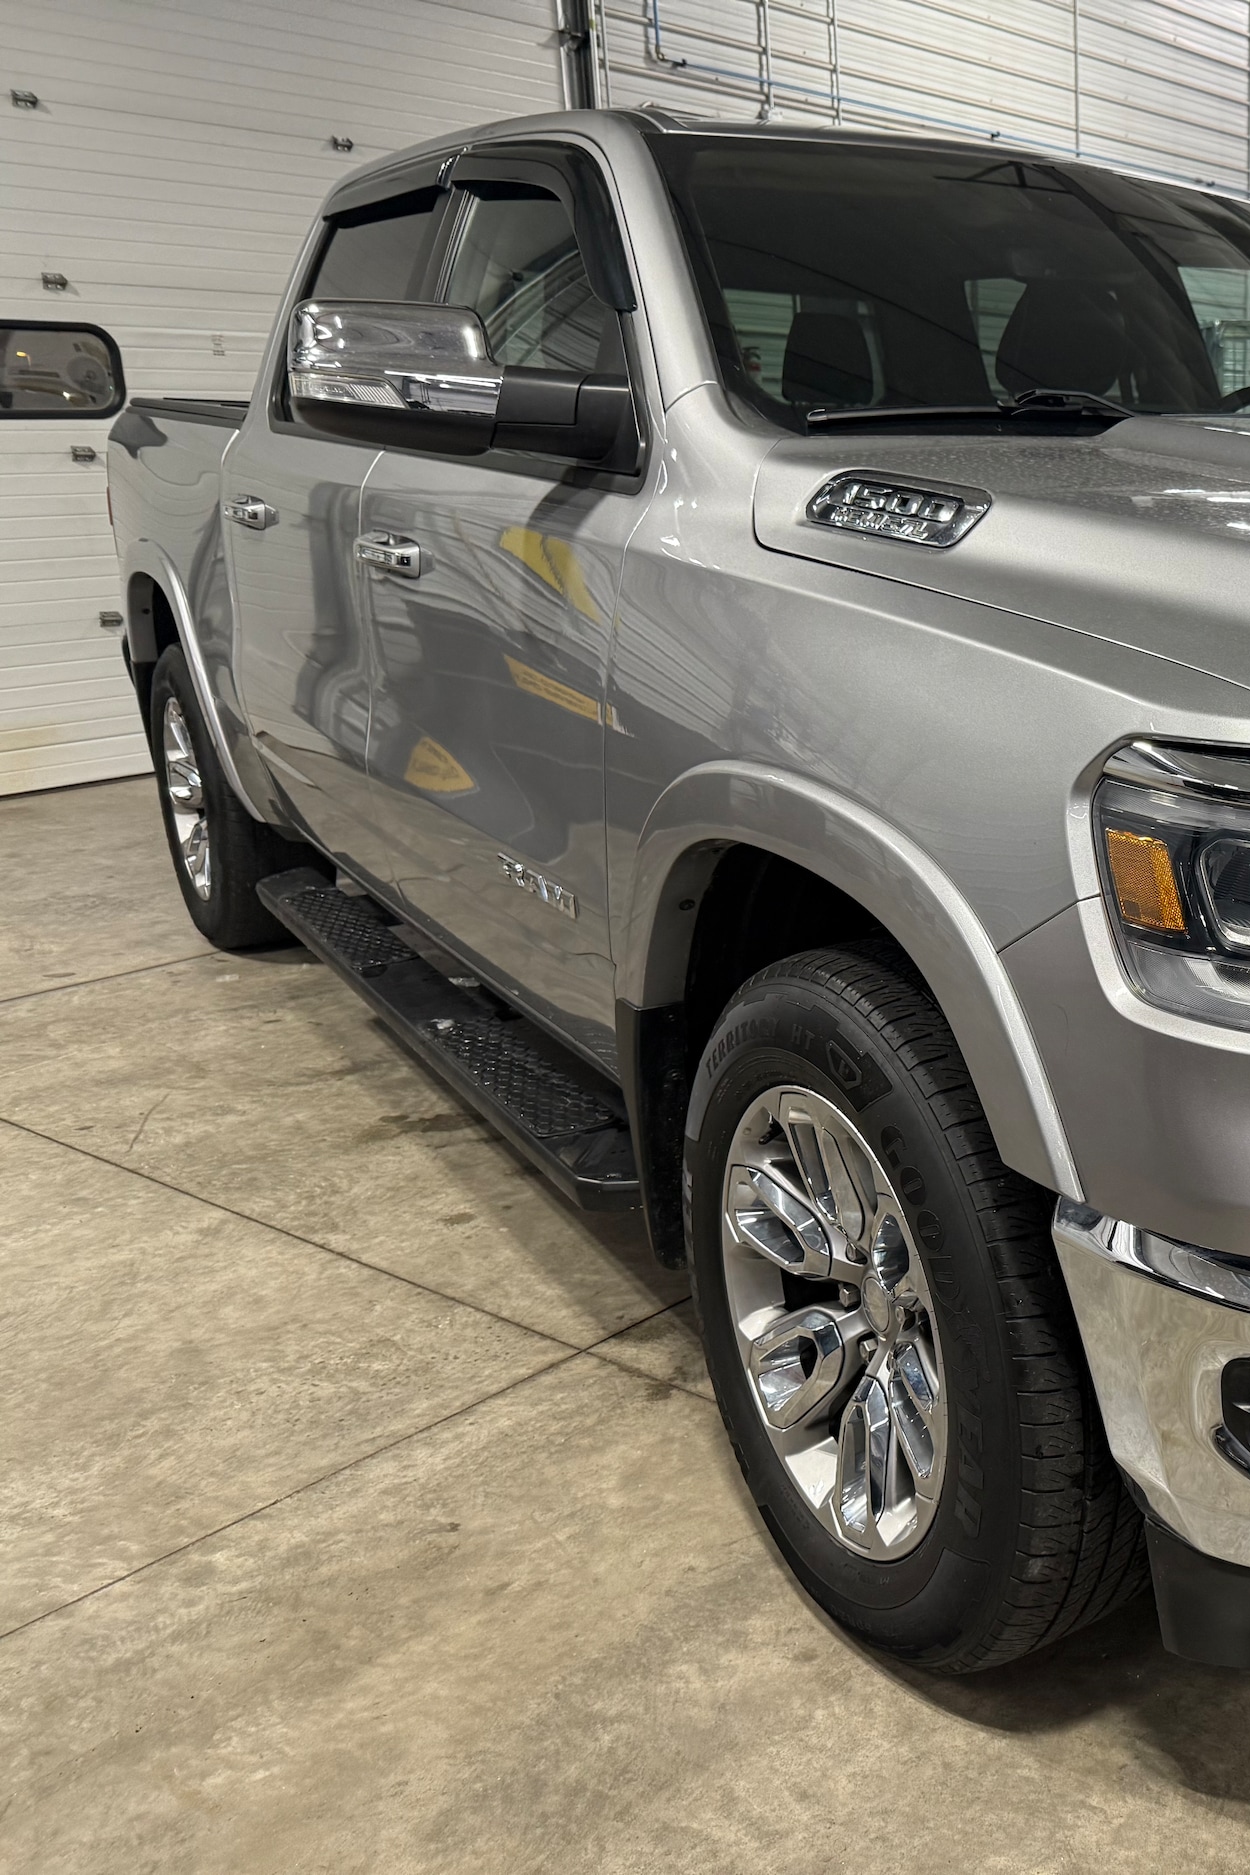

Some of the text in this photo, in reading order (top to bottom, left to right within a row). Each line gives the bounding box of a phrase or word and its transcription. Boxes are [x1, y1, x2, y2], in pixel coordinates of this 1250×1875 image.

[842, 482, 960, 523] 1500
[705, 1016, 816, 1080] TERRITORY HT
[881, 1124, 985, 1539] GOODYEAR
